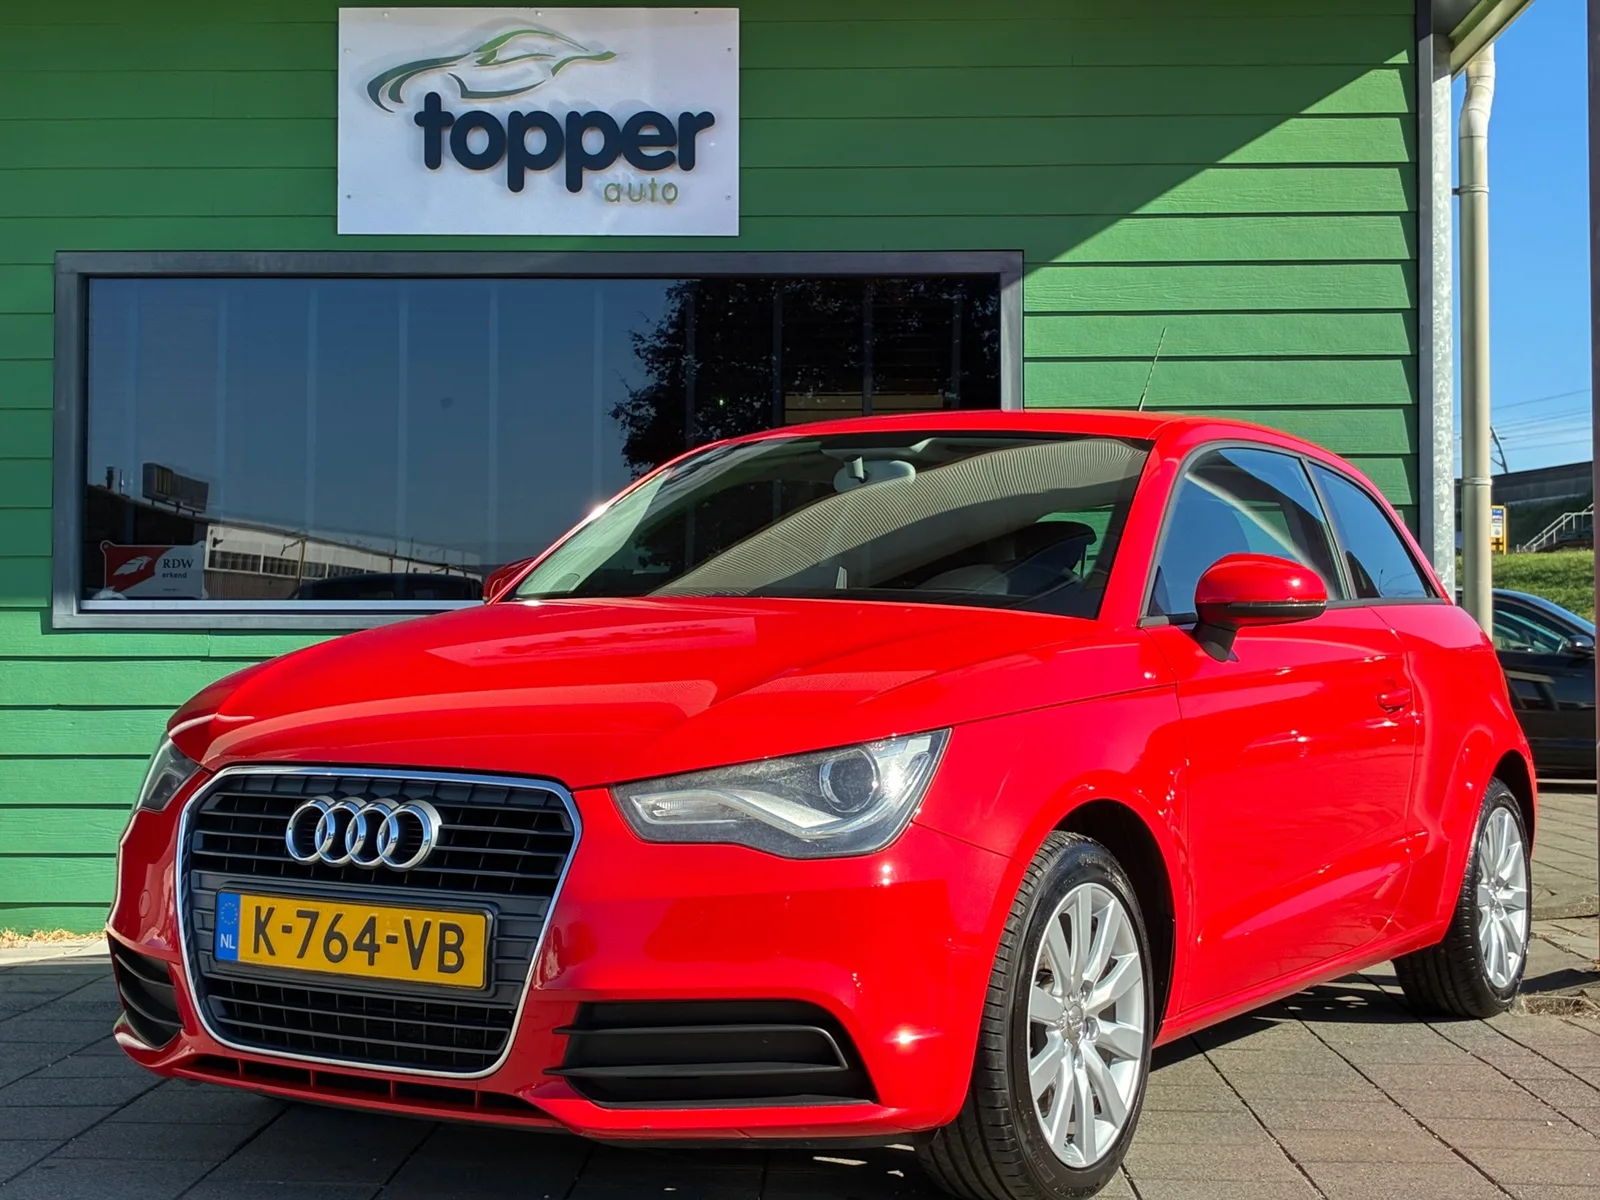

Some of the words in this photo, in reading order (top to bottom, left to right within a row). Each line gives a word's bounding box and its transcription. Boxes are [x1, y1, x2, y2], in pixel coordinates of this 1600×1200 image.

[413, 91, 716, 193] topper
[603, 177, 679, 204] auto
[162, 559, 194, 569] RDW
[219, 933, 236, 950] NL
[252, 905, 465, 974] K-764-VB
